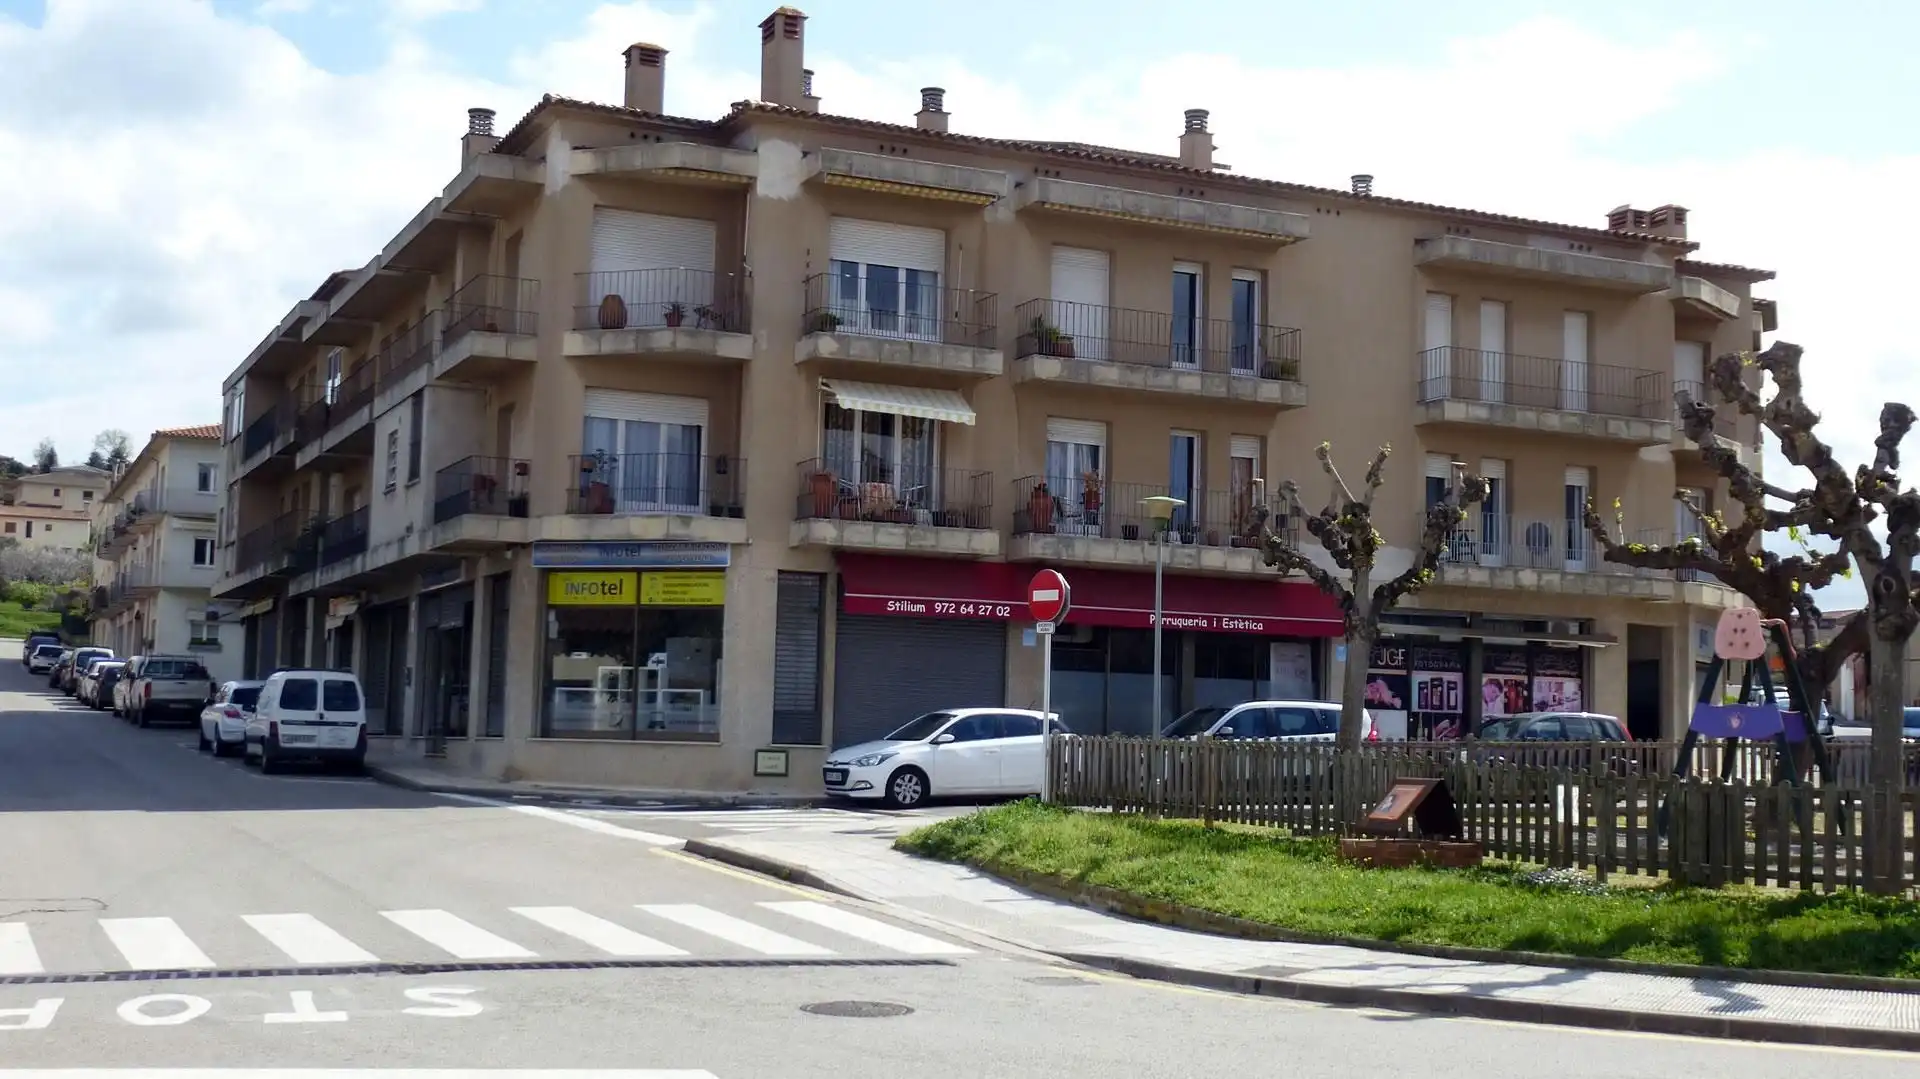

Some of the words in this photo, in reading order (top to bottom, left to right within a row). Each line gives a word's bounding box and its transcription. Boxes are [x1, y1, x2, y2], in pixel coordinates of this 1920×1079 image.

[887, 600, 926, 613] Stilium
[934, 602, 956, 614] 972
[960, 604, 975, 615] 64
[978, 605, 993, 616] 27
[996, 606, 1011, 617] 02
[1149, 614, 1207, 628] Prruqueria
[1213, 618, 1217, 628] i
[1222, 618, 1264, 630] Estètica
[0, 986, 484, 1031] STOP
